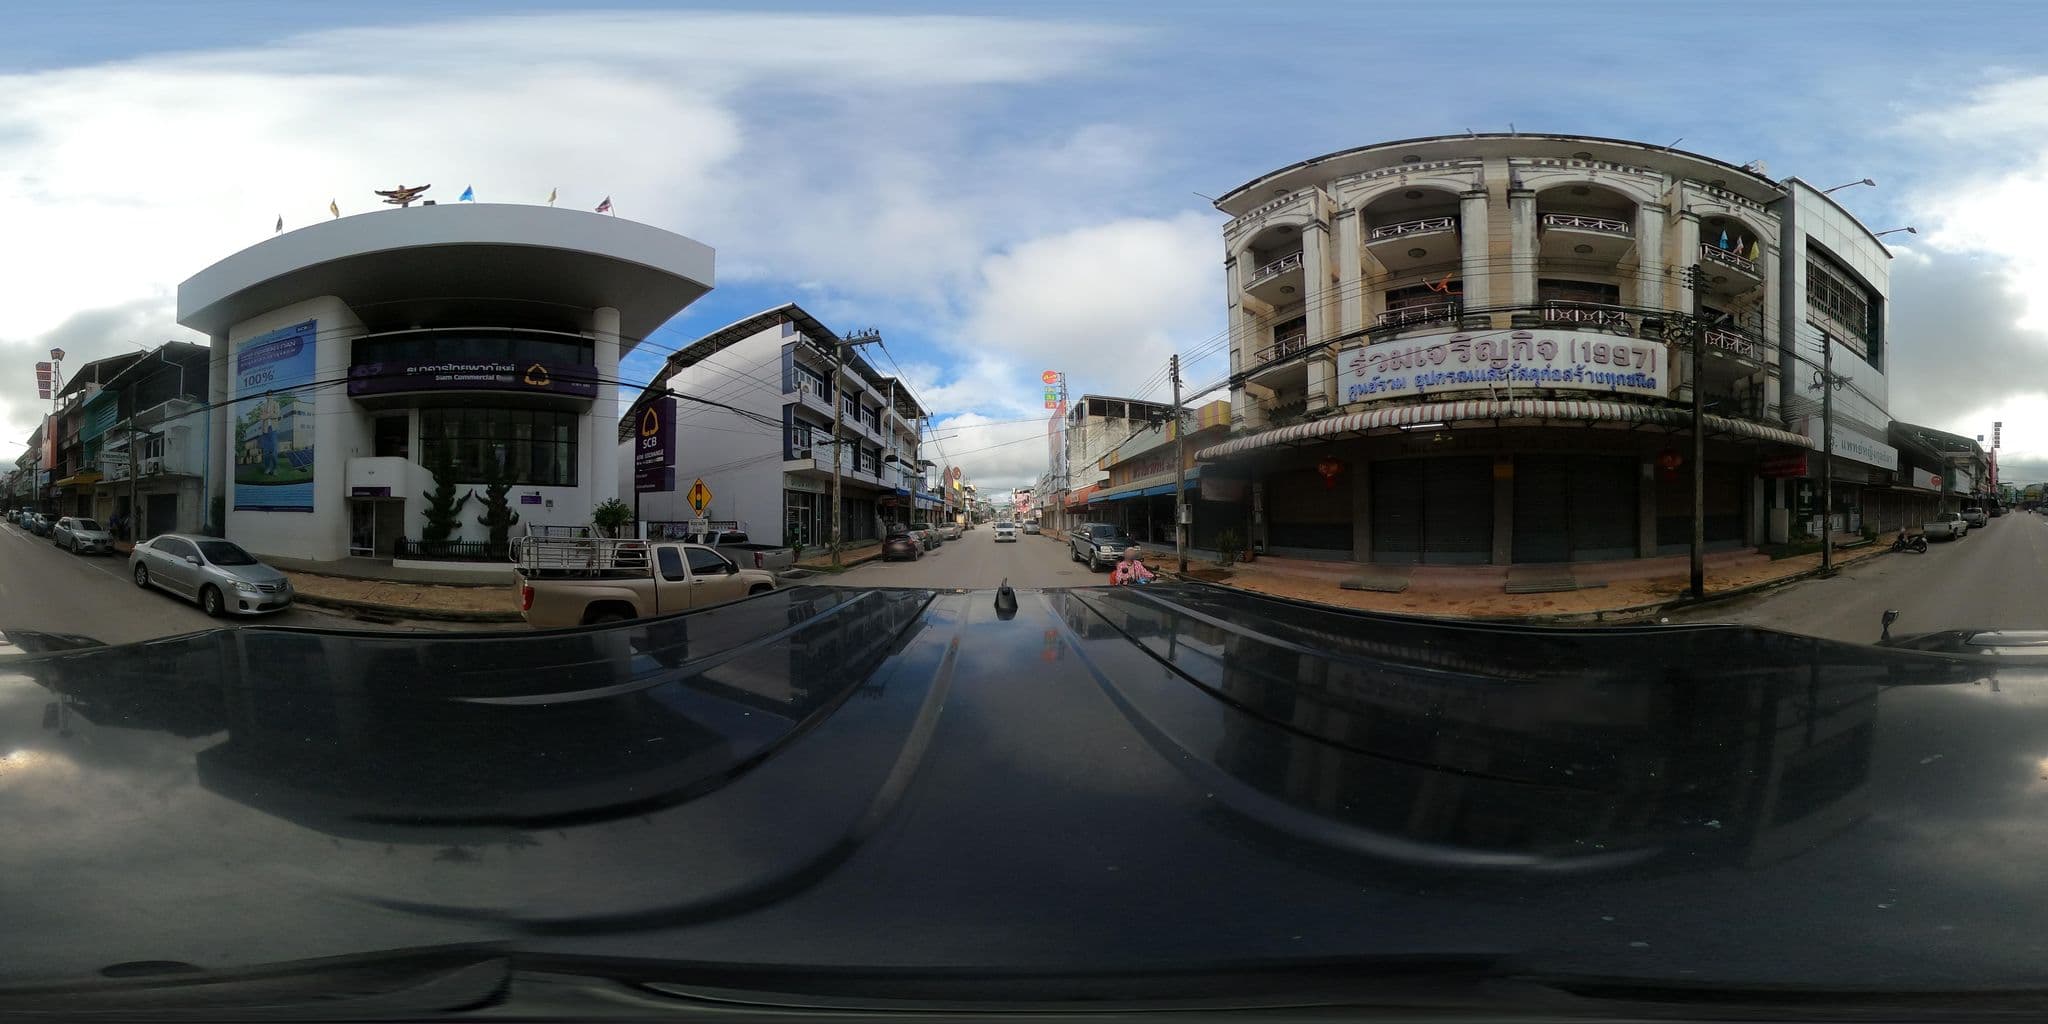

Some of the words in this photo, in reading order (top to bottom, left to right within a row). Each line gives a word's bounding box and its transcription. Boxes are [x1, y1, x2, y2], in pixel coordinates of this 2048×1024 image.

[1349, 331, 1559, 377] ร่วมเจริญกิจ
[1570, 338, 1657, 372] (1997)
[643, 436, 657, 449] SCB
